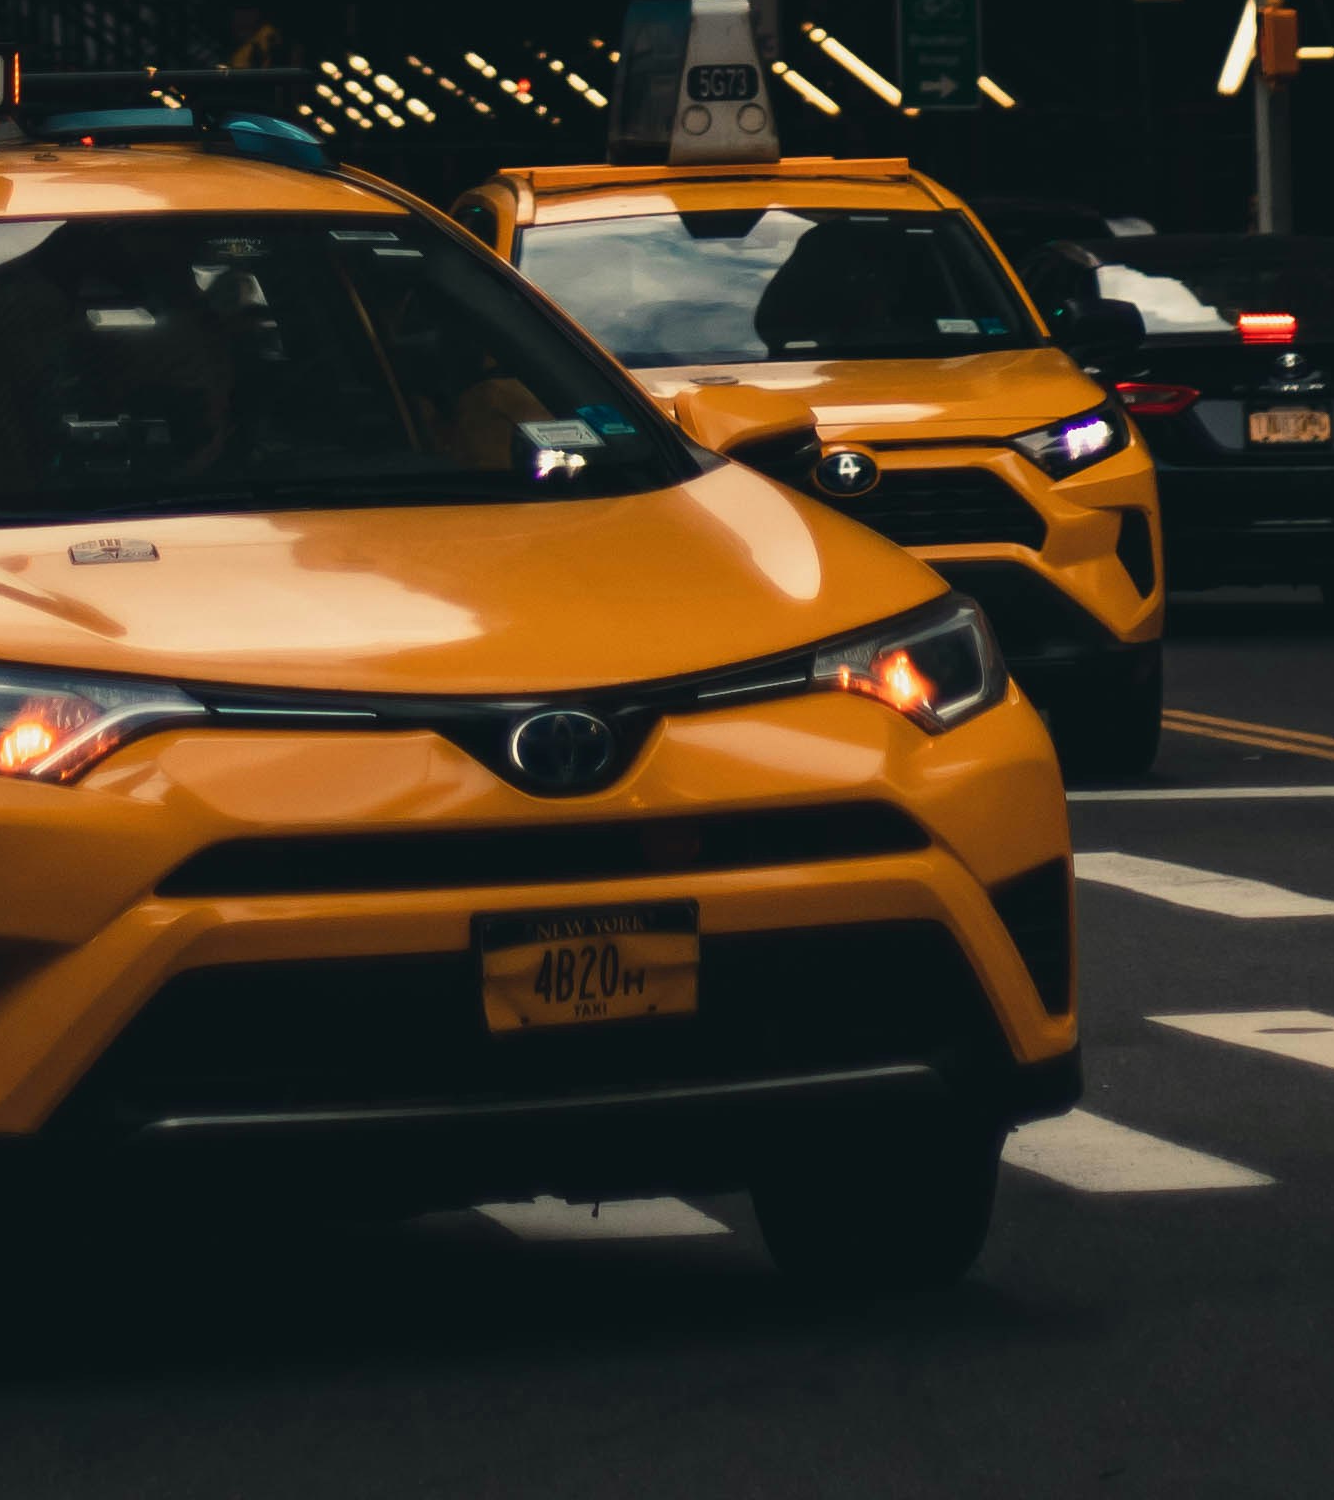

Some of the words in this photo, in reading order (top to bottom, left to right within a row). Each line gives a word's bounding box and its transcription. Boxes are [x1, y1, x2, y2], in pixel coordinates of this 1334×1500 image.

[699, 68, 747, 98] 5G73
[537, 918, 585, 941] NEW
[593, 915, 646, 934] YORK
[574, 1002, 608, 1018] TAXI
